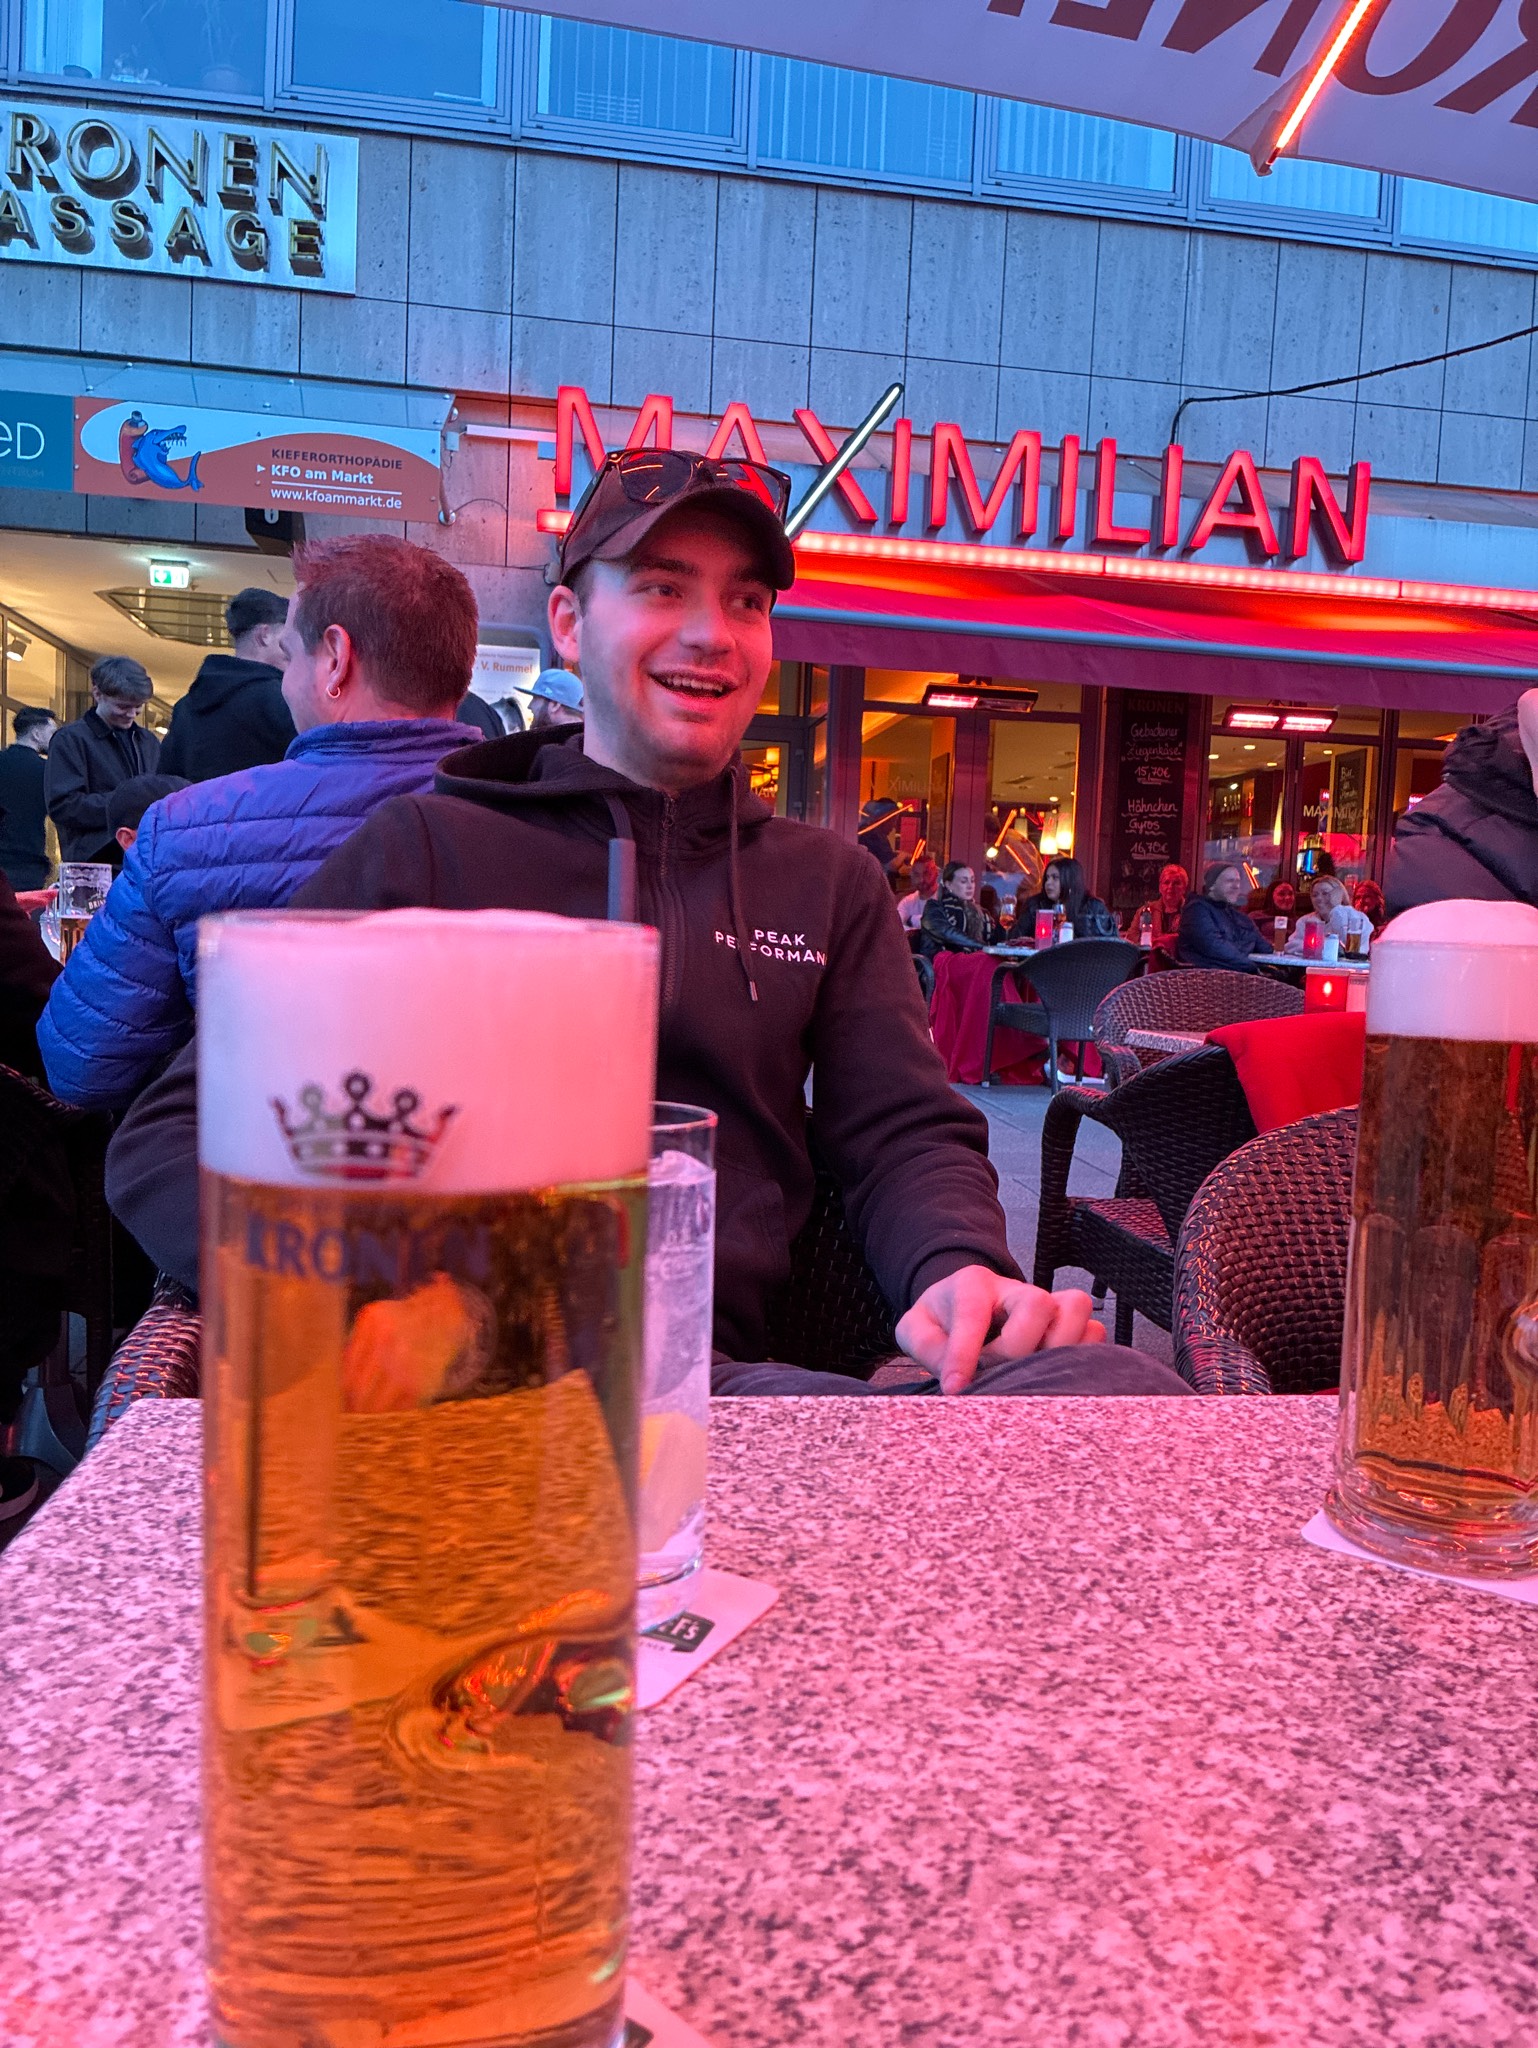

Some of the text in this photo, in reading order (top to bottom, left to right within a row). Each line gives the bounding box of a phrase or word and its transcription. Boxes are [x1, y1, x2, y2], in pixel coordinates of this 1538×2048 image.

[0, 112, 330, 221] RONEN
[271, 448, 403, 470] KIEFERORTHOPÄDIE
[271, 464, 374, 484] KFO am Markt
[554, 384, 1372, 564] MAXIMILIAN
[270, 487, 403, 509] www.kfoammarkt.de
[492, 662, 533, 674] Rummel
[715, 931, 827, 966] PEFORMAN
[754, 929, 805, 946] PEAK
